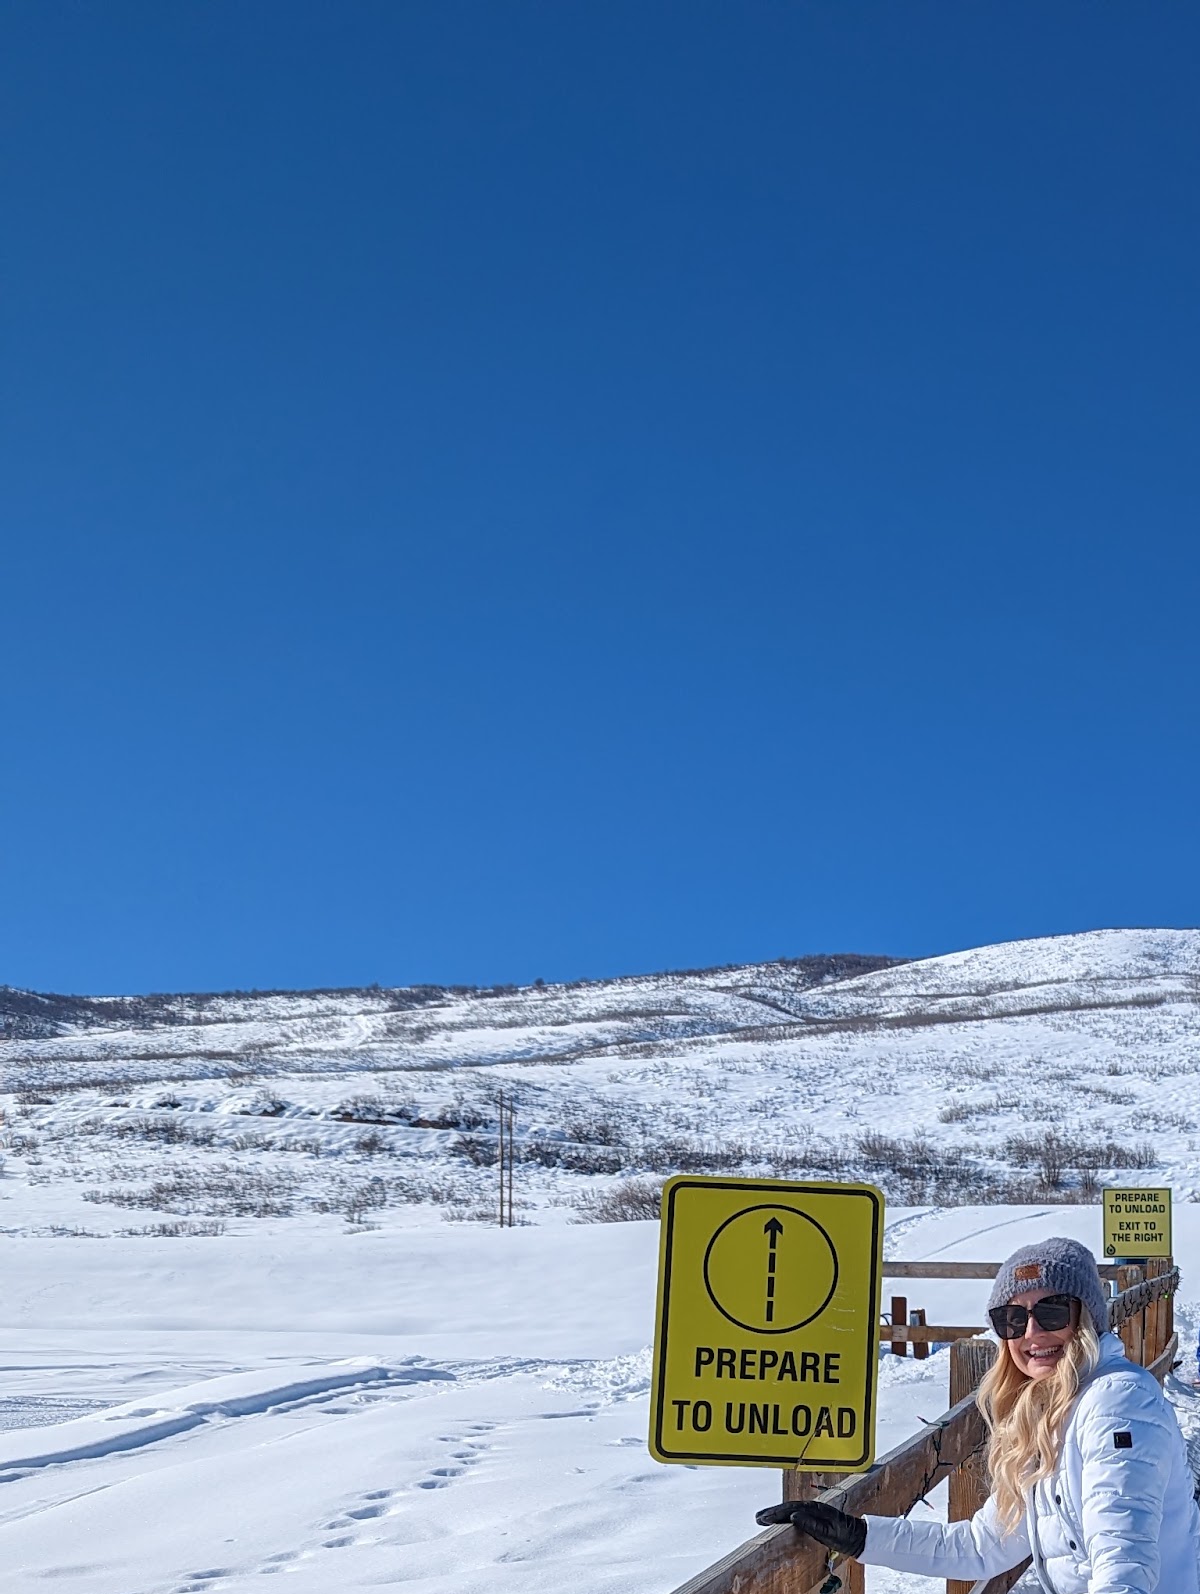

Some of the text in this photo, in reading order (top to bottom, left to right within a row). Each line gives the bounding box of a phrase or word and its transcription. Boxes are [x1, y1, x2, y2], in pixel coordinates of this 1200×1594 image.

[1115, 1193, 1160, 1202] PREPARE
[1109, 1204, 1166, 1213] TO UNLOAD
[1119, 1221, 1156, 1230] EXIT TO
[1112, 1233, 1164, 1242] THE RIGHT
[694, 1346, 841, 1384] PREPARE
[672, 1400, 856, 1438] TO UNLOAD
